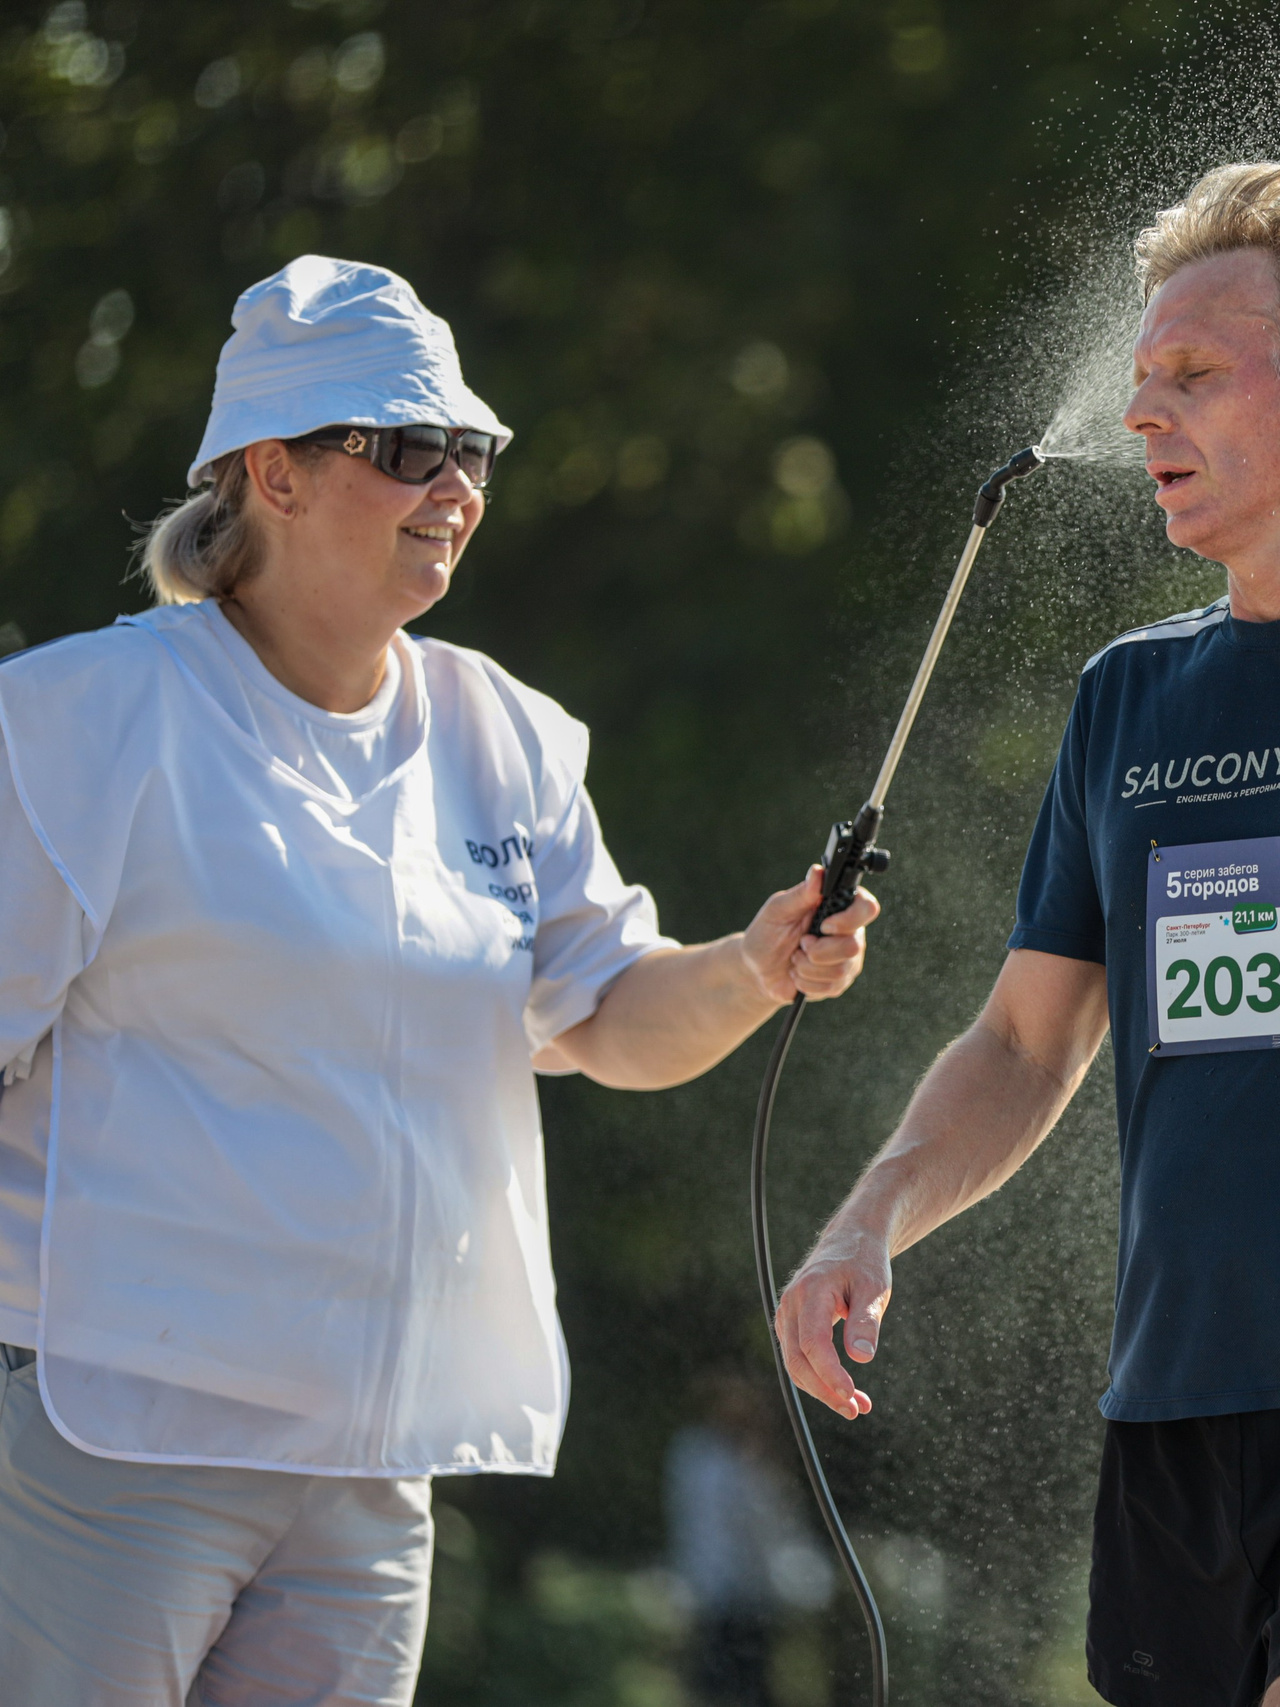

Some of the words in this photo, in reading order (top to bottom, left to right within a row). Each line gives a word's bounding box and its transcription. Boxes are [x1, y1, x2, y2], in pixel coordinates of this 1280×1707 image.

[1176, 791, 1232, 804] ENGINEERING
[1184, 868, 1215, 881] серия
[1218, 864, 1259, 877] забегов
[1166, 871, 1182, 899] 5
[1183, 877, 1259, 900] городов
[1234, 910, 1255, 925] 21,1
[1166, 923, 1211, 931] Санкт-Петербург
